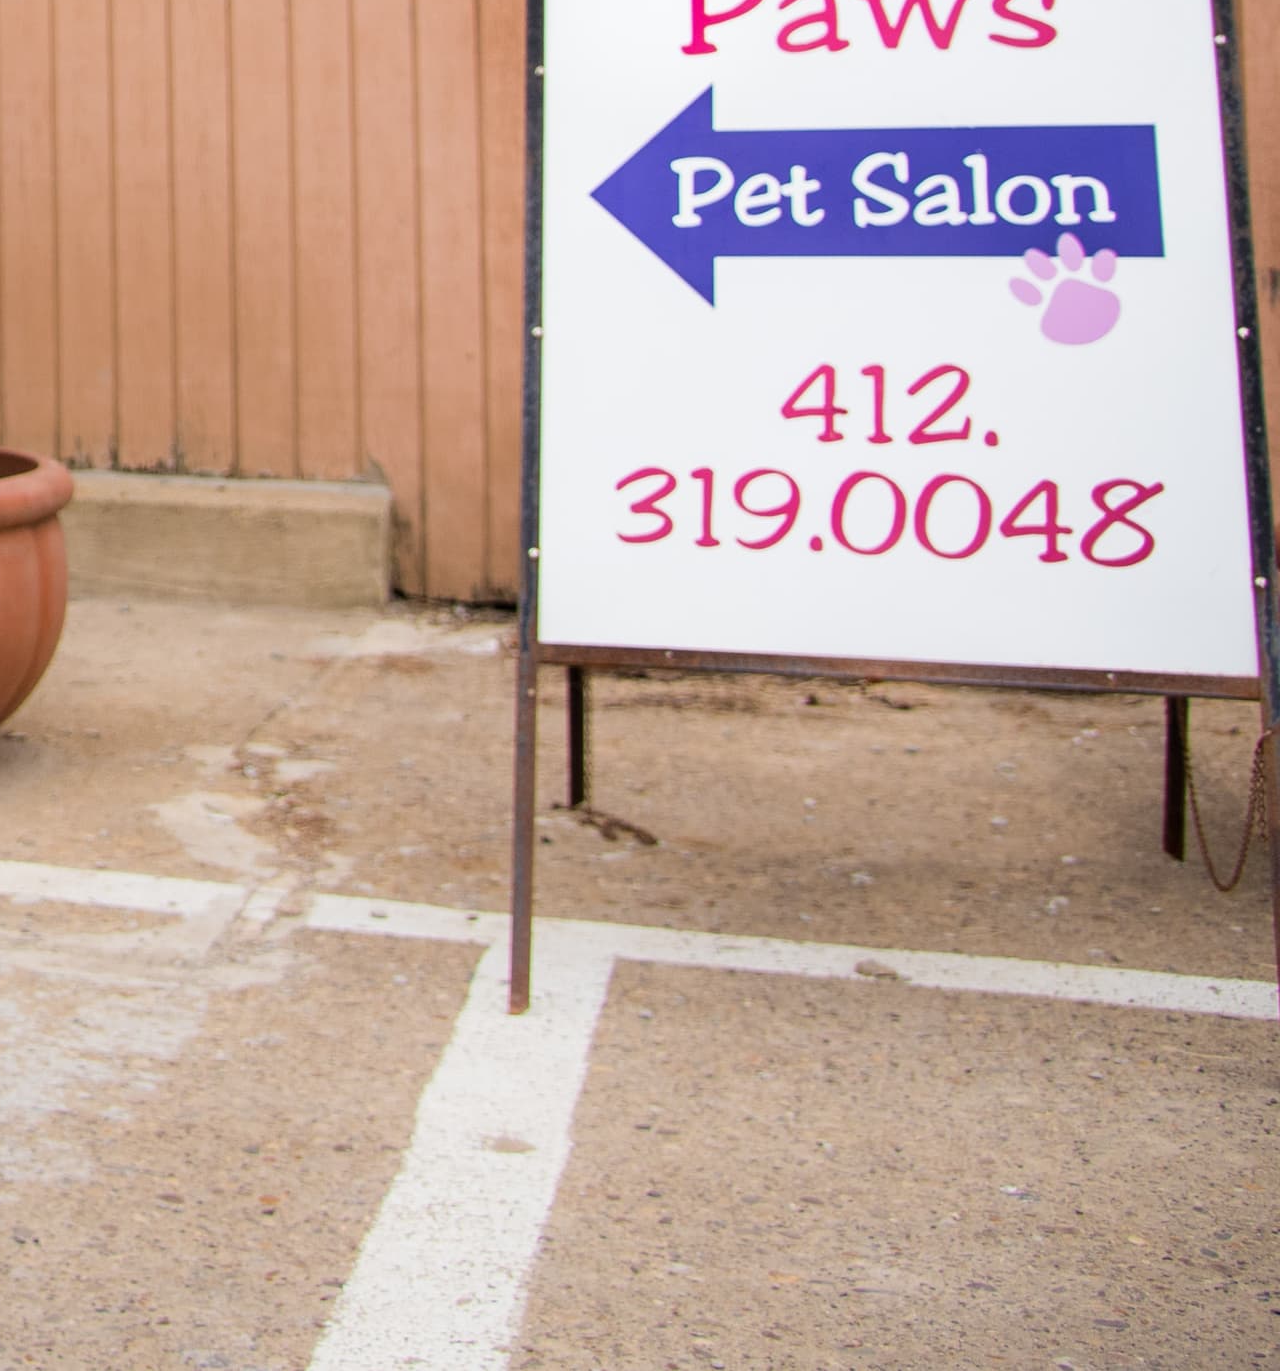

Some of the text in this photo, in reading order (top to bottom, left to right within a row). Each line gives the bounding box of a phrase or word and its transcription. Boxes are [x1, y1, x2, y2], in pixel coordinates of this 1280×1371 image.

[670, 152, 1117, 228] Pet Salon
[780, 363, 1000, 447] 412.
[614, 466, 1165, 568] 319.0048
